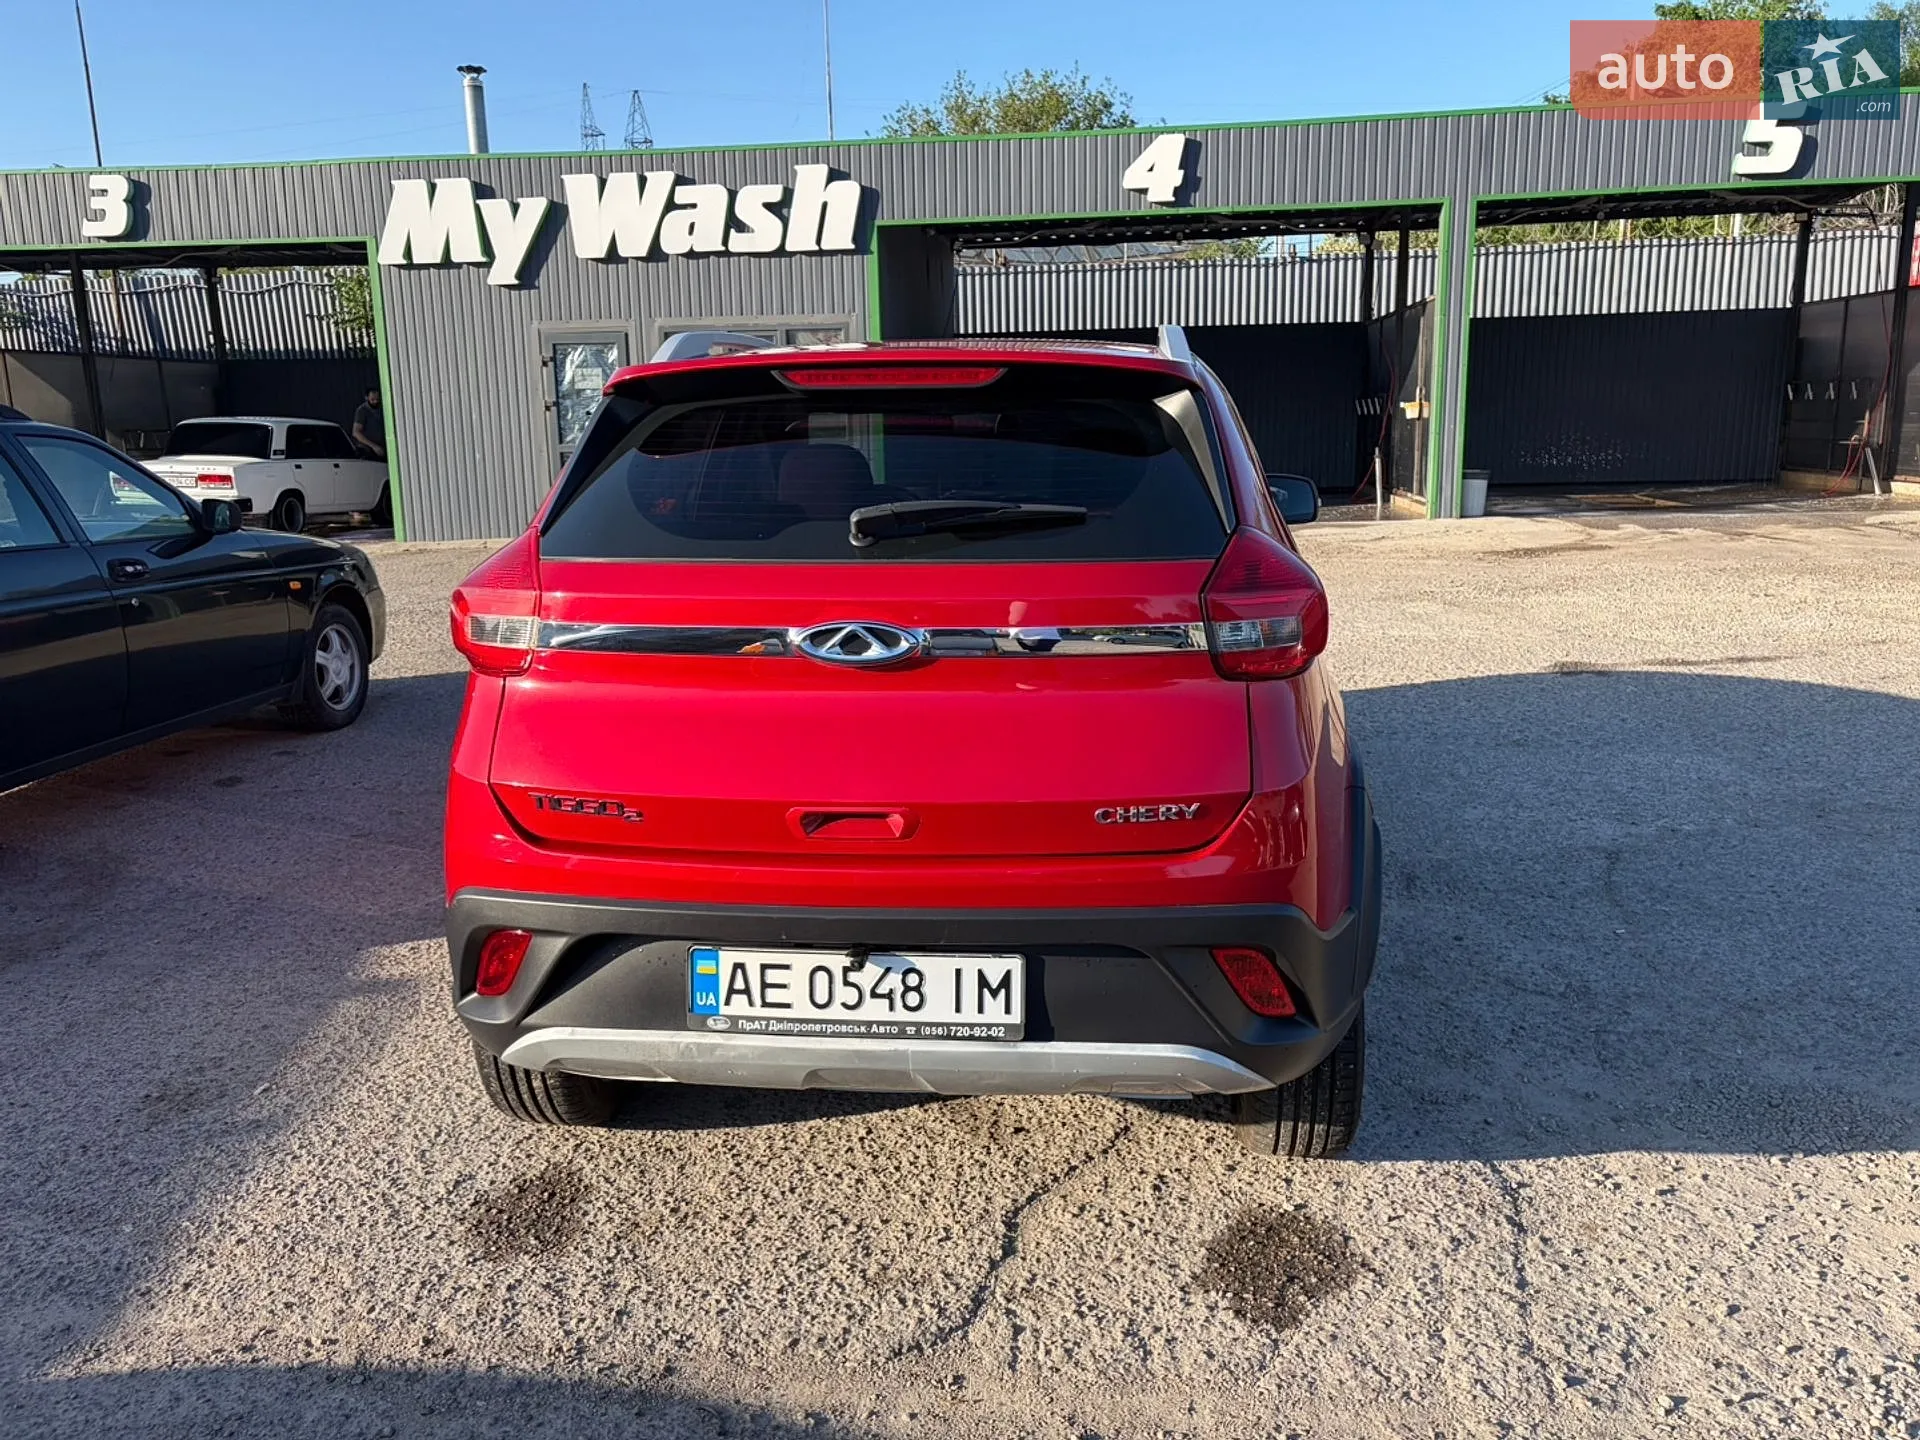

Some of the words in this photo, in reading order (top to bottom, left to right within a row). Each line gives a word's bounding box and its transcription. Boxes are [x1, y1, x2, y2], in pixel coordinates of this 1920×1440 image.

[1122, 133, 1186, 202] 4
[1733, 102, 1808, 175] 5
[82, 174, 131, 238] 3
[377, 176, 549, 286] My
[560, 163, 862, 259] Wash
[1094, 803, 1200, 824] CHERY
[696, 991, 717, 1007] UA
[723, 961, 793, 1010] AE
[809, 964, 926, 1013] 0548
[954, 967, 1013, 1016] IM
[738, 1019, 767, 1032] ПрАТ
[920, 1025, 947, 1037] (056)
[950, 1026, 1005, 1037] 720-92-02
